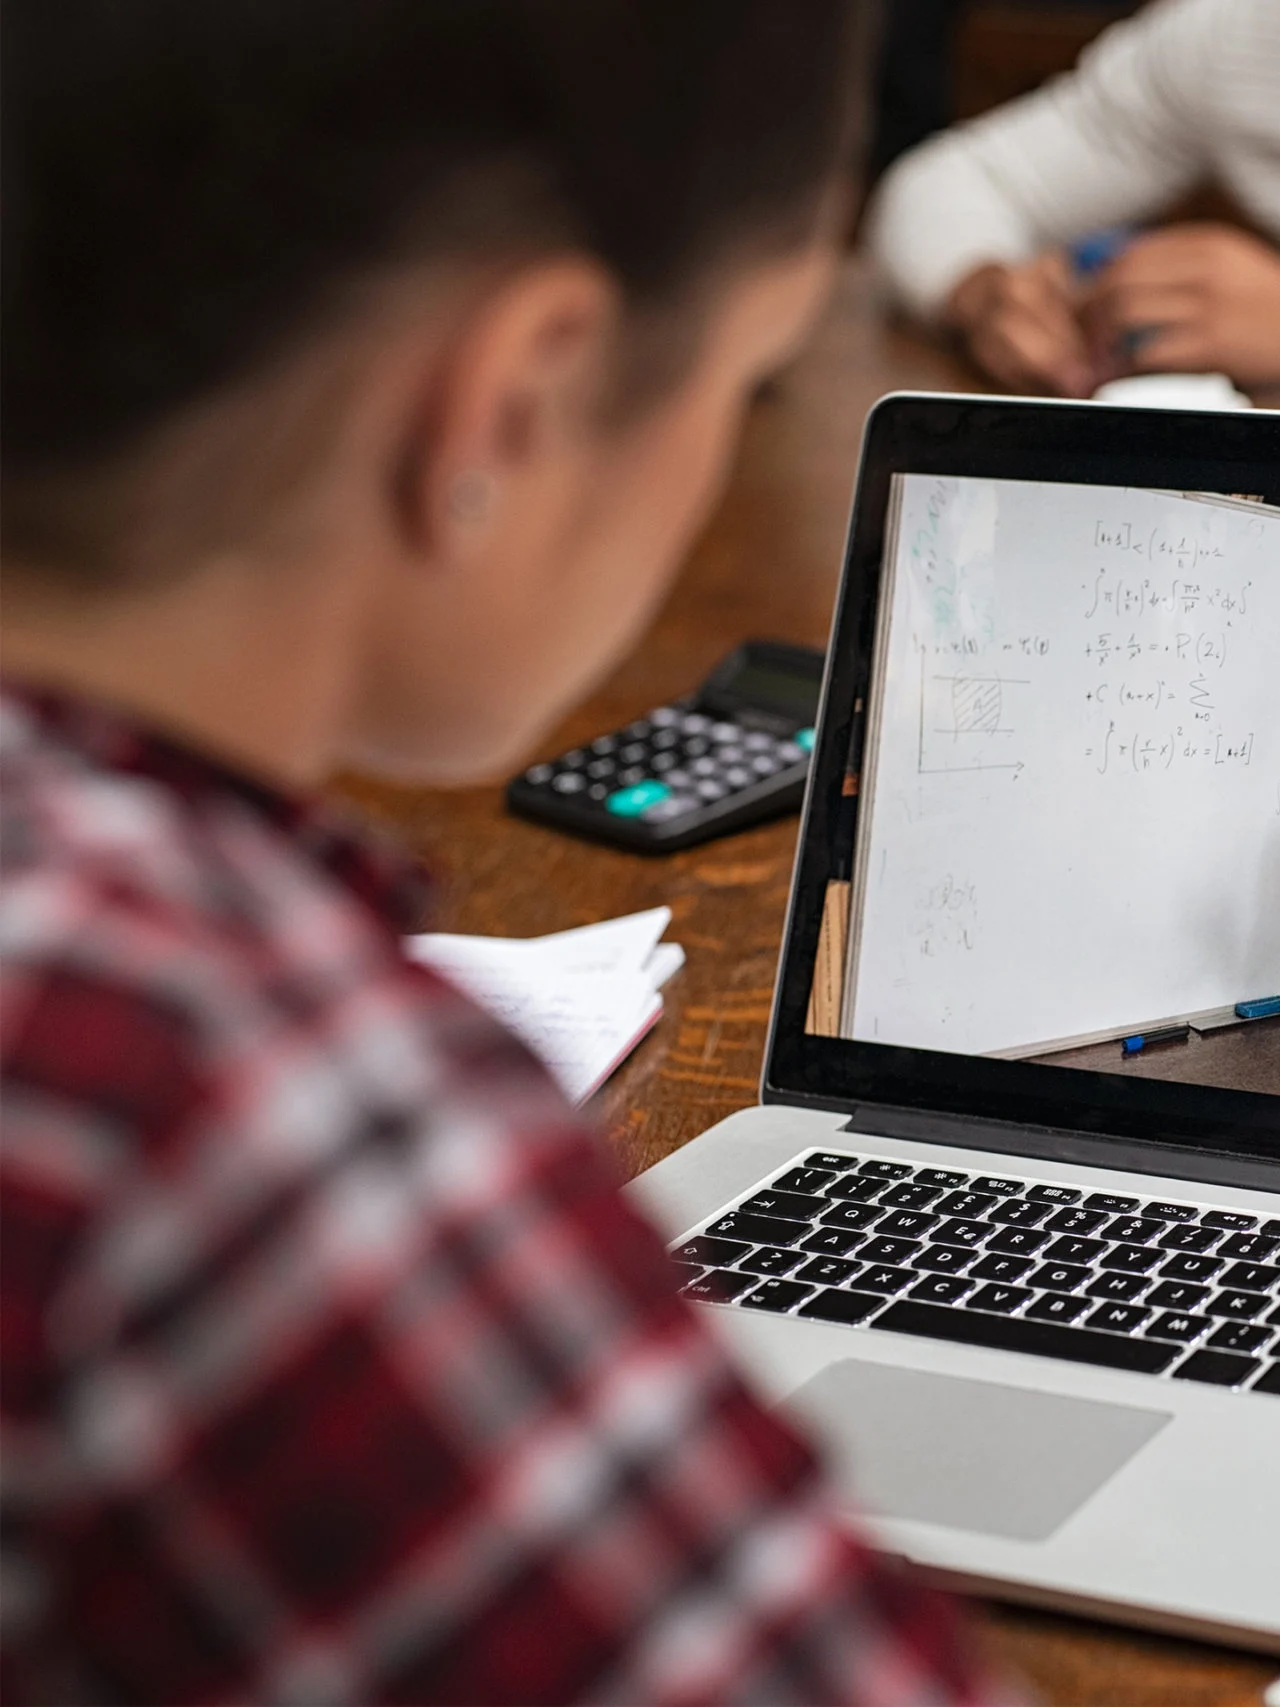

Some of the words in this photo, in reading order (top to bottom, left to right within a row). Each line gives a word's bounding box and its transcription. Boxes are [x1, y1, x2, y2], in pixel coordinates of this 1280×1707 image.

[844, 1209, 859, 1218] Q
[1008, 1211, 1021, 1219] 4
[897, 1217, 917, 1227] W
[1064, 1219, 1077, 1227] 5
[1121, 1228, 1133, 1236] 6
[824, 1236, 839, 1245] A
[1010, 1234, 1025, 1244] R
[881, 1244, 895, 1253] S
[1070, 1243, 1083, 1252] T
[936, 1252, 952, 1262] D
[1128, 1252, 1141, 1261] Y
[820, 1264, 837, 1273] Z
[994, 1262, 1009, 1271] F
[1184, 1260, 1200, 1270] U
[874, 1273, 893, 1283] X
[1051, 1271, 1068, 1280] G
[934, 1282, 950, 1292] C
[1108, 1279, 1127, 1290] H
[691, 1285, 711, 1294] ctrl
[1170, 1289, 1185, 1299] J
[993, 1291, 1009, 1302] V
[1049, 1300, 1065, 1312] B
[1108, 1309, 1128, 1321] N
[1167, 1318, 1189, 1331] M
